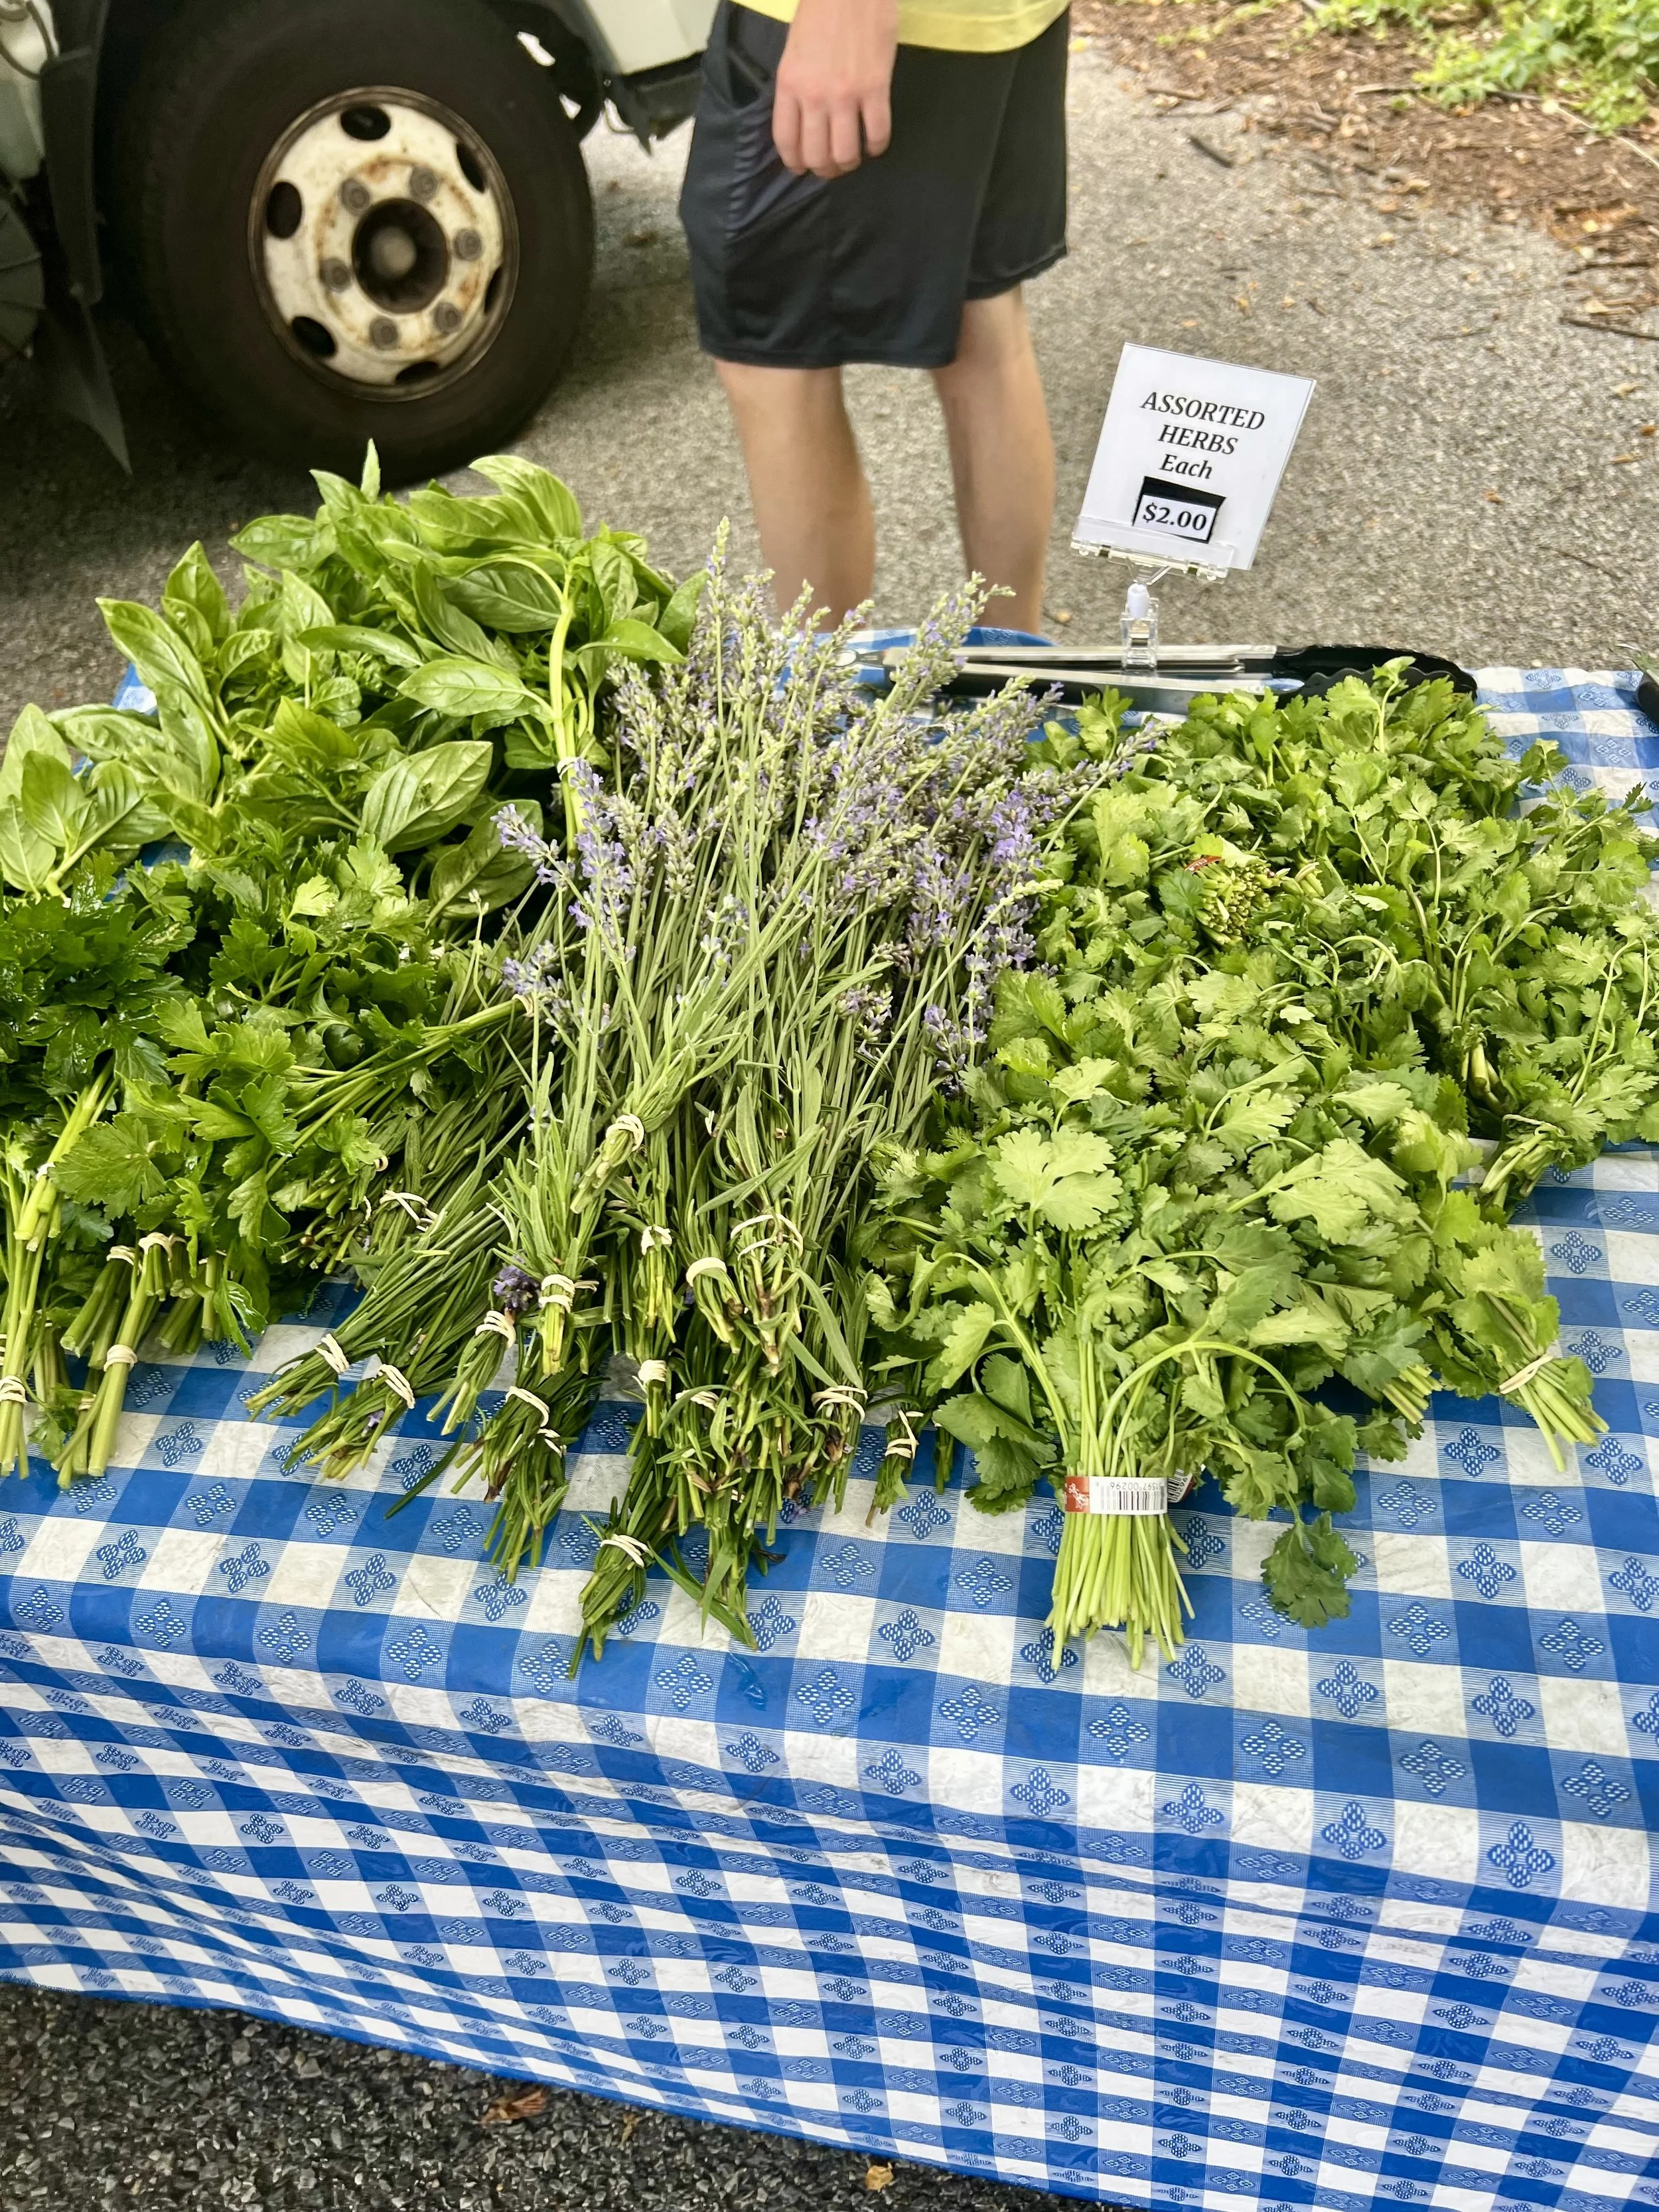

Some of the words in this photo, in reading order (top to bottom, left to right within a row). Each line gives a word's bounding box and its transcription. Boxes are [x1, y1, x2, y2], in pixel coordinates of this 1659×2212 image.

[1140, 392, 1265, 429] ASSORTED
[1158, 425, 1238, 455] HERBS
[1159, 453, 1212, 479] Each
[1143, 503, 1206, 530] $2.00
[1110, 1482, 1139, 1491] 00296
